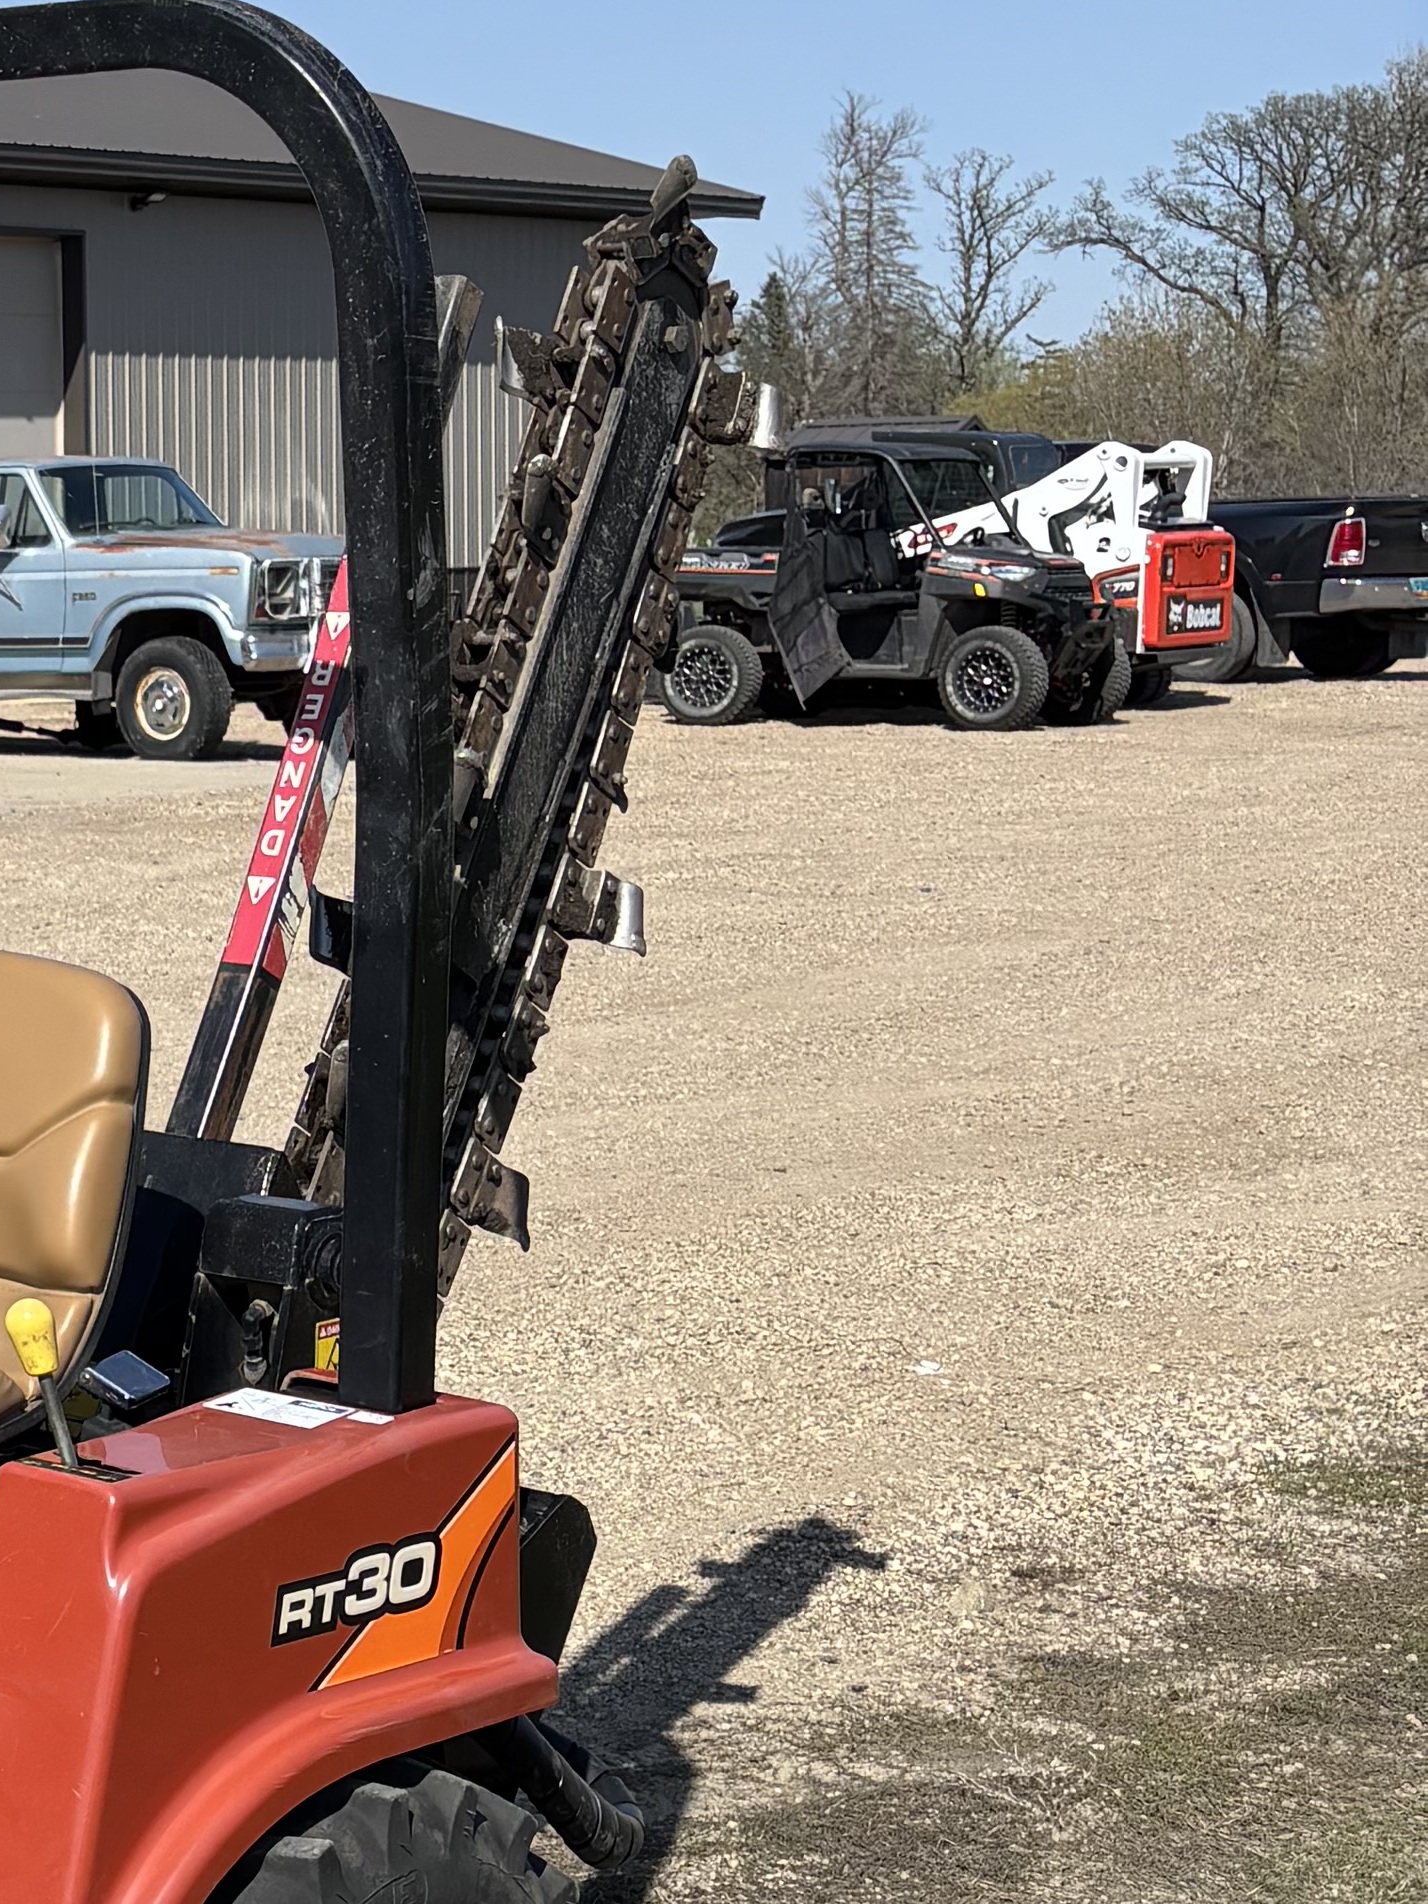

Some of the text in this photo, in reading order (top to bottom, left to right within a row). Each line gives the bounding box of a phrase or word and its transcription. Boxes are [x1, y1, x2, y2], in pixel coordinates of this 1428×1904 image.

[1186, 603, 1221, 629] Bobcat
[260, 660, 336, 856] DANGER
[278, 1541, 436, 1636] RT30
